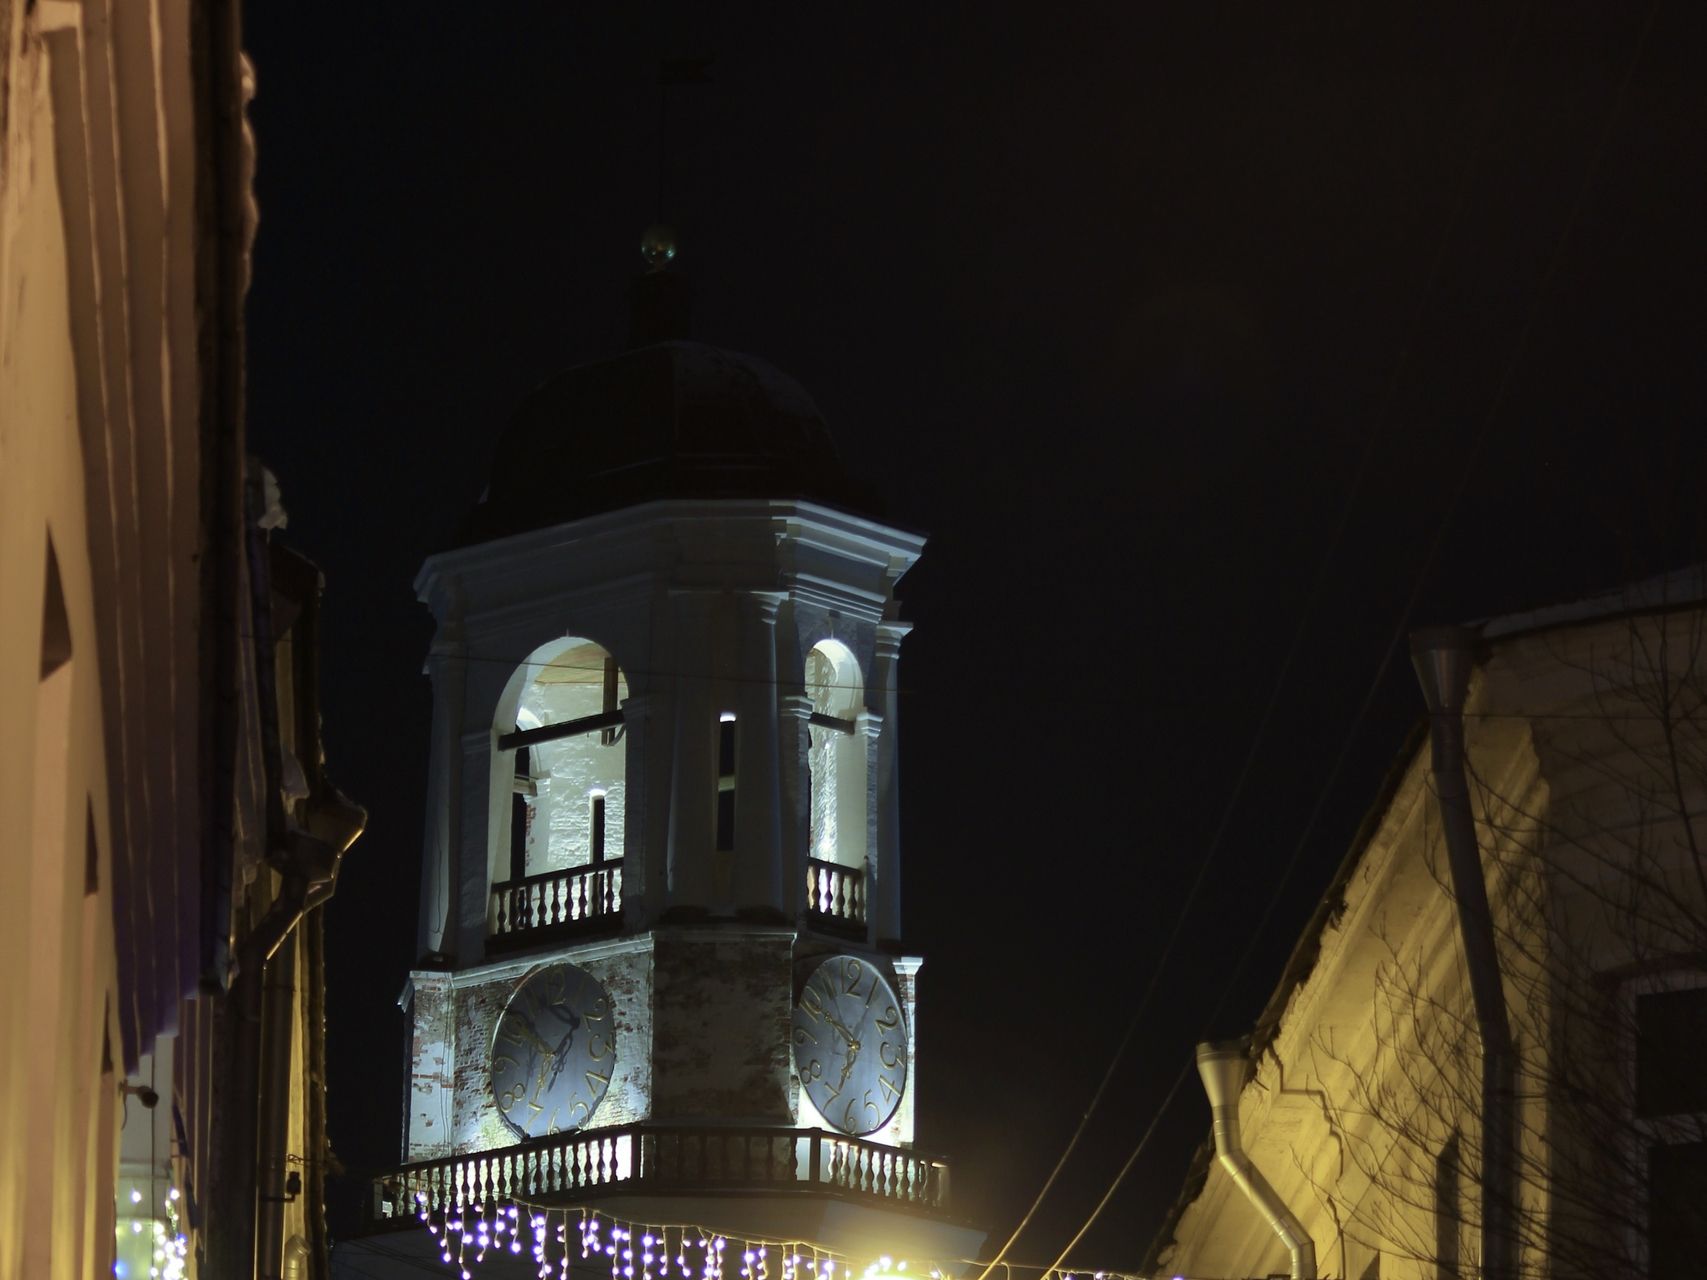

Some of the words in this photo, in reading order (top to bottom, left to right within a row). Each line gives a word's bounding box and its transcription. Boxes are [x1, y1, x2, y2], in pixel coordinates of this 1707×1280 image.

[544, 968, 566, 1006] 12
[817, 964, 837, 1000] 11
[840, 956, 862, 998] 12
[865, 977, 879, 1008] 1
[582, 998, 608, 1032] 2
[799, 985, 823, 1024] 10
[794, 1028, 818, 1046] 9
[875, 1006, 898, 1037] 2
[588, 1034, 613, 1062] 3
[880, 1041, 905, 1070] 3
[494, 1056, 520, 1075] 9
[801, 1059, 822, 1085] 8
[500, 1083, 526, 1112] 8
[586, 1070, 609, 1096] 4
[823, 1081, 841, 1113] 7
[878, 1074, 902, 1104] 4
[525, 1101, 544, 1132] 7
[569, 1091, 590, 1130] 5
[844, 1098, 857, 1135] 6
[863, 1089, 880, 1131] 5
